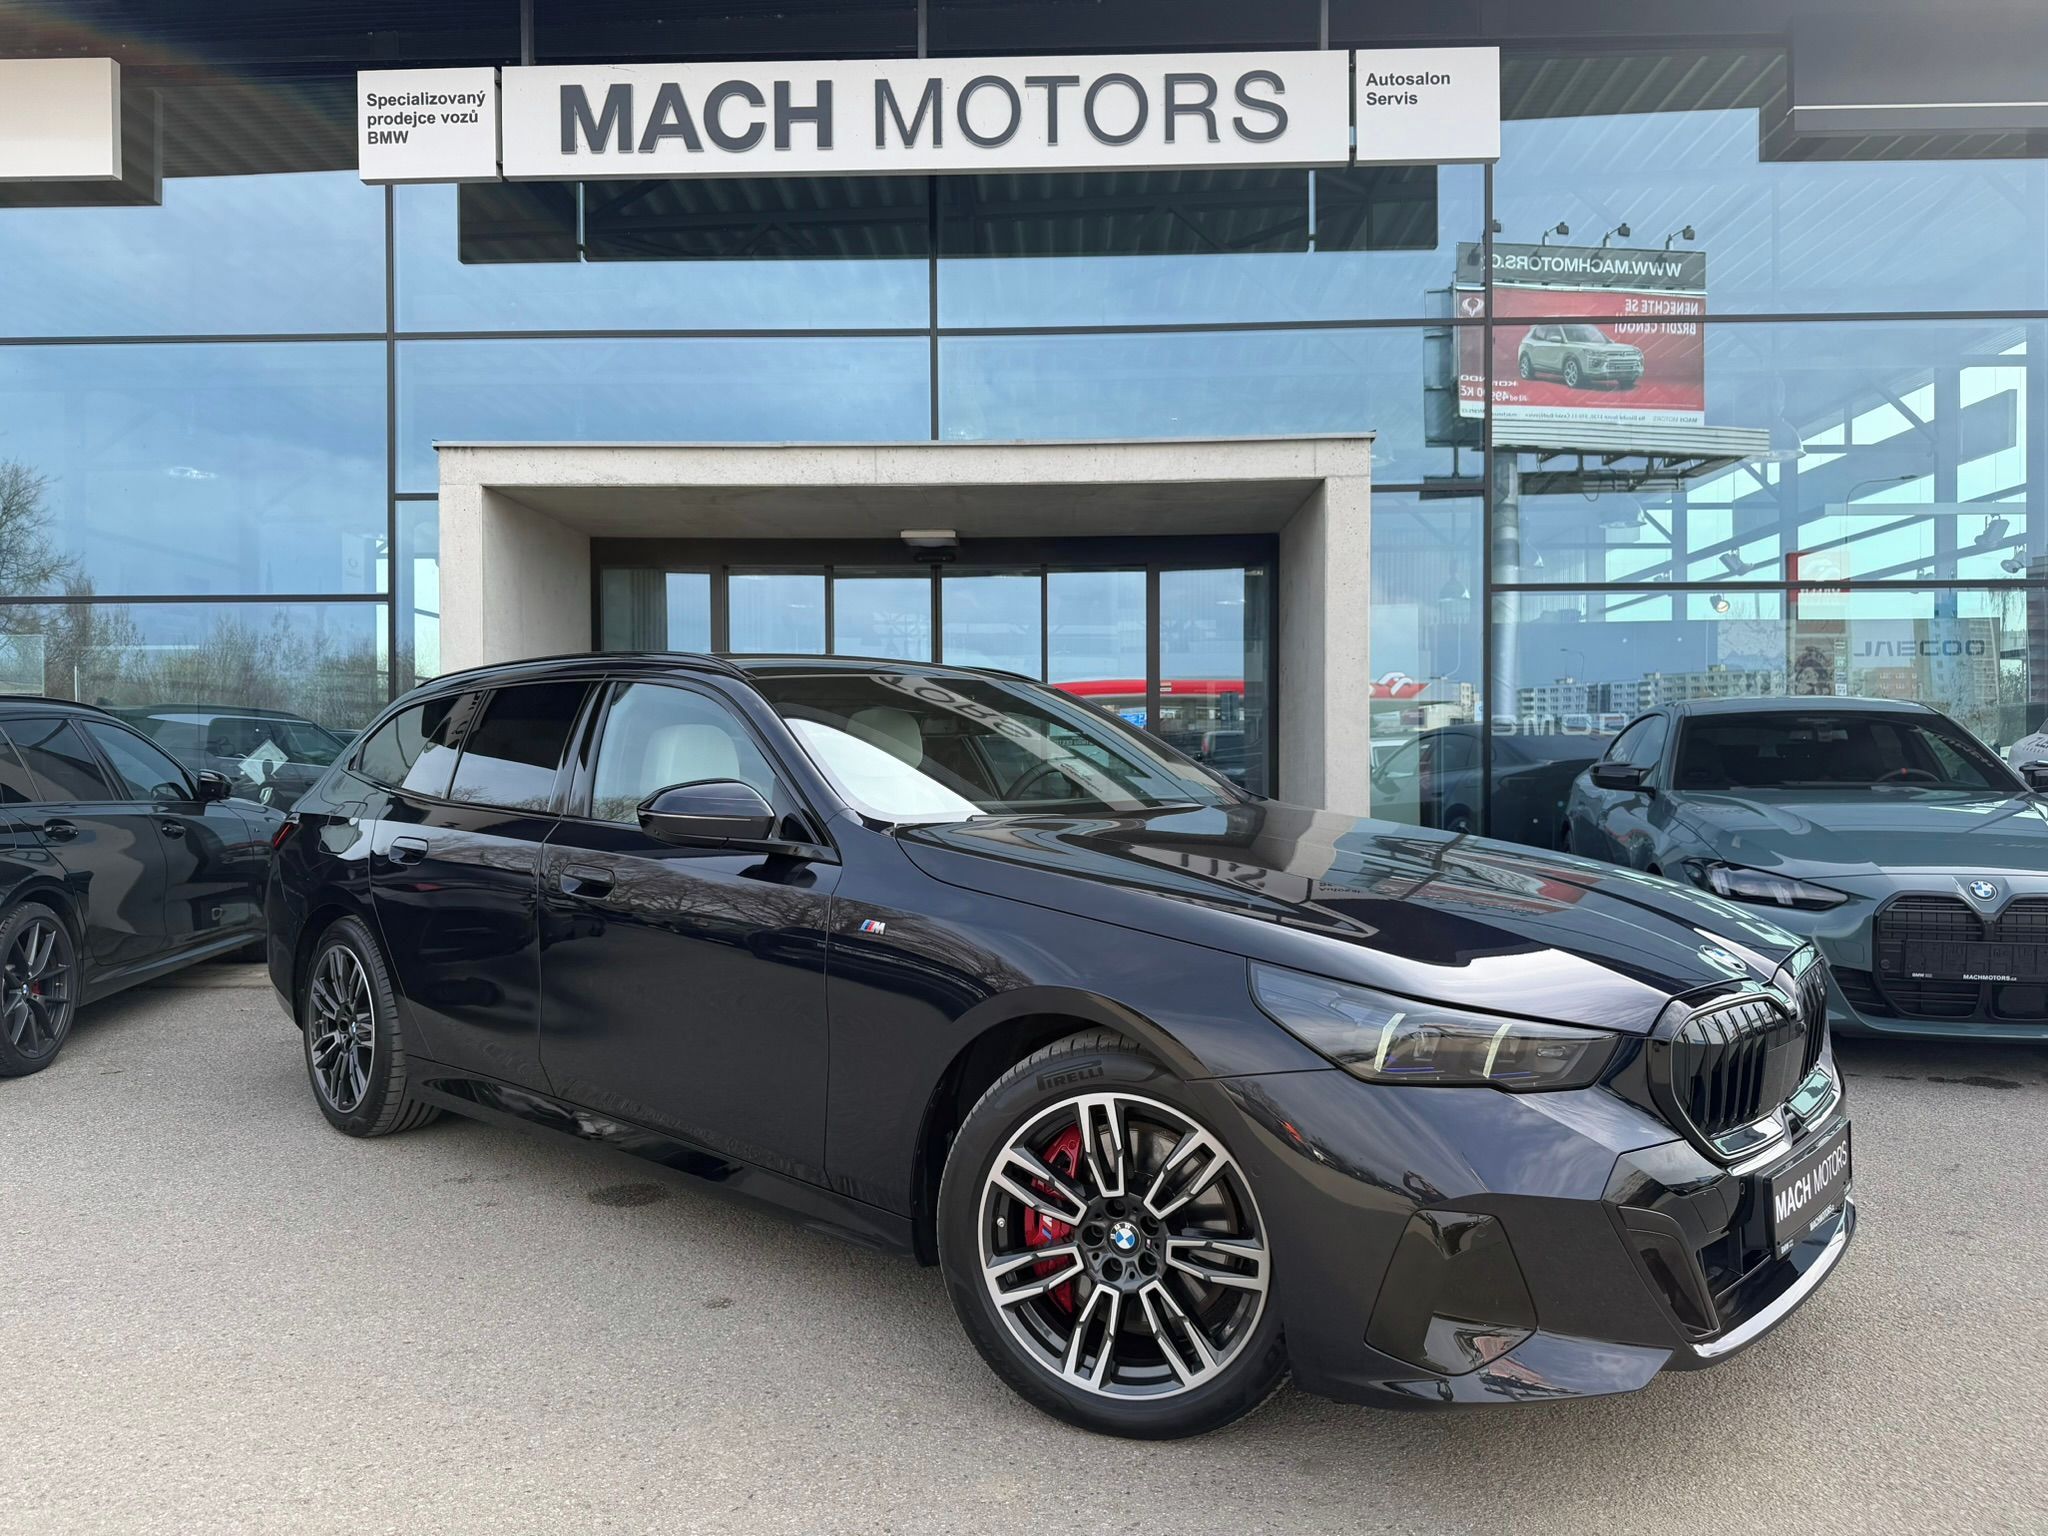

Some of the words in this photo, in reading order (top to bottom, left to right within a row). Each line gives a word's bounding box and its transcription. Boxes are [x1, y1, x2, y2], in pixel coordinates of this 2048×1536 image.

[1366, 71, 1451, 86] Autosalon
[366, 90, 486, 108] Specializovaný
[1366, 90, 1419, 106] Servis
[367, 110, 438, 128] prodejce
[441, 108, 479, 124] vozů
[560, 78, 834, 154] MACH
[875, 69, 1289, 148] MOTORS
[367, 130, 410, 145] BMW
[1036, 1061, 1105, 1092] PIRELLI
[1775, 1173, 1812, 1224] MACH
[1813, 1140, 1848, 1195] MOTORS
